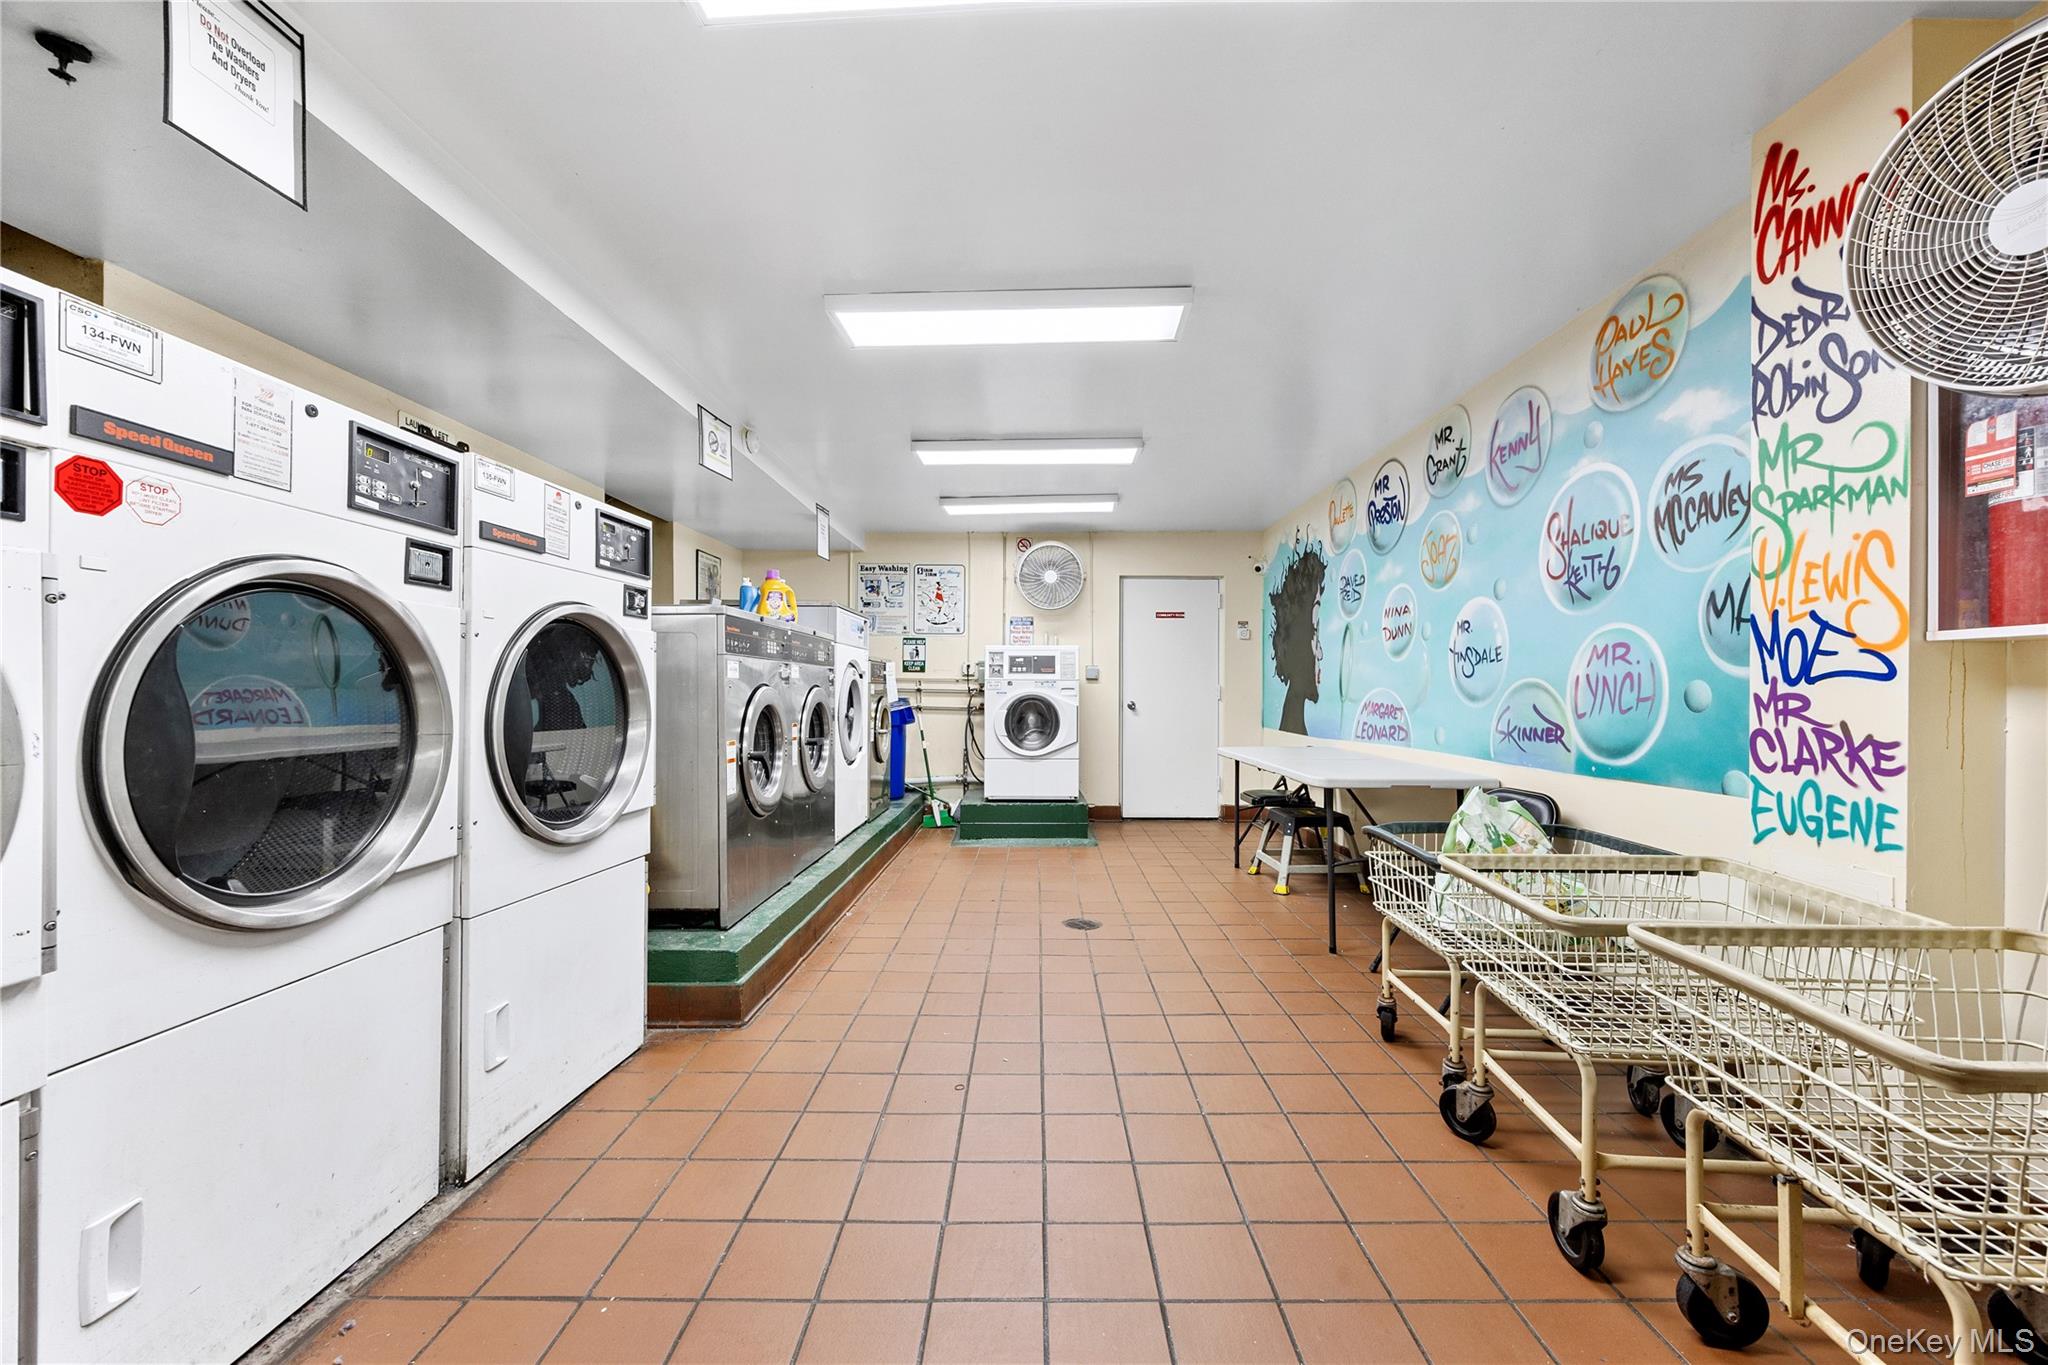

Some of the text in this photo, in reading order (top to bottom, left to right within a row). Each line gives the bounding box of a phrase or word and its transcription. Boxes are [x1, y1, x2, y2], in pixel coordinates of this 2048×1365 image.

[200, 13, 266, 72] Do Not Overload
[207, 33, 260, 81] The Washers
[211, 51, 256, 92] And Dryers
[234, 83, 254, 102] Thank
[1754, 142, 1816, 240] Ms.
[69, 304, 92, 317] CSC
[1595, 292, 1685, 376] PAUL
[1751, 276, 1850, 367] DEDR
[81, 324, 142, 354] 134-FWN
[1593, 327, 1675, 404] HAYES
[103, 421, 161, 449] Speed
[162, 437, 214, 462] Queen
[1434, 425, 1455, 450] MR.
[1489, 400, 1541, 491] KENNY
[1757, 421, 1899, 491] MR
[73, 462, 108, 477] STOP
[1426, 438, 1467, 485] GRANT
[1665, 459, 1704, 495] MS
[140, 482, 169, 495] STOP
[1367, 475, 1406, 538] PRESTON
[1374, 475, 1390, 498] MR
[1750, 424, 1910, 582] SPARKMAN
[1654, 469, 1751, 554] MCCAULEY
[492, 527, 537, 546] Speed Queen
[1547, 497, 1634, 580] SHALIQUE
[860, 564, 908, 573] Easy Washing
[1563, 546, 1621, 604] KEITH
[1382, 622, 1412, 641] DUNN
[1384, 604, 1411, 618] NINA
[1457, 619, 1473, 635] MR.
[1586, 641, 1641, 668] MR.
[1750, 609, 1898, 687] MOE
[1361, 700, 1404, 720] MARGARET
[1574, 659, 1656, 720] LYNCH
[1753, 676, 1834, 728] MR
[1355, 719, 1409, 742] LEONARD
[1495, 703, 1572, 753] SKINNER
[1750, 720, 1906, 792] CLARKE
[1750, 774, 1904, 852] EUGENE
